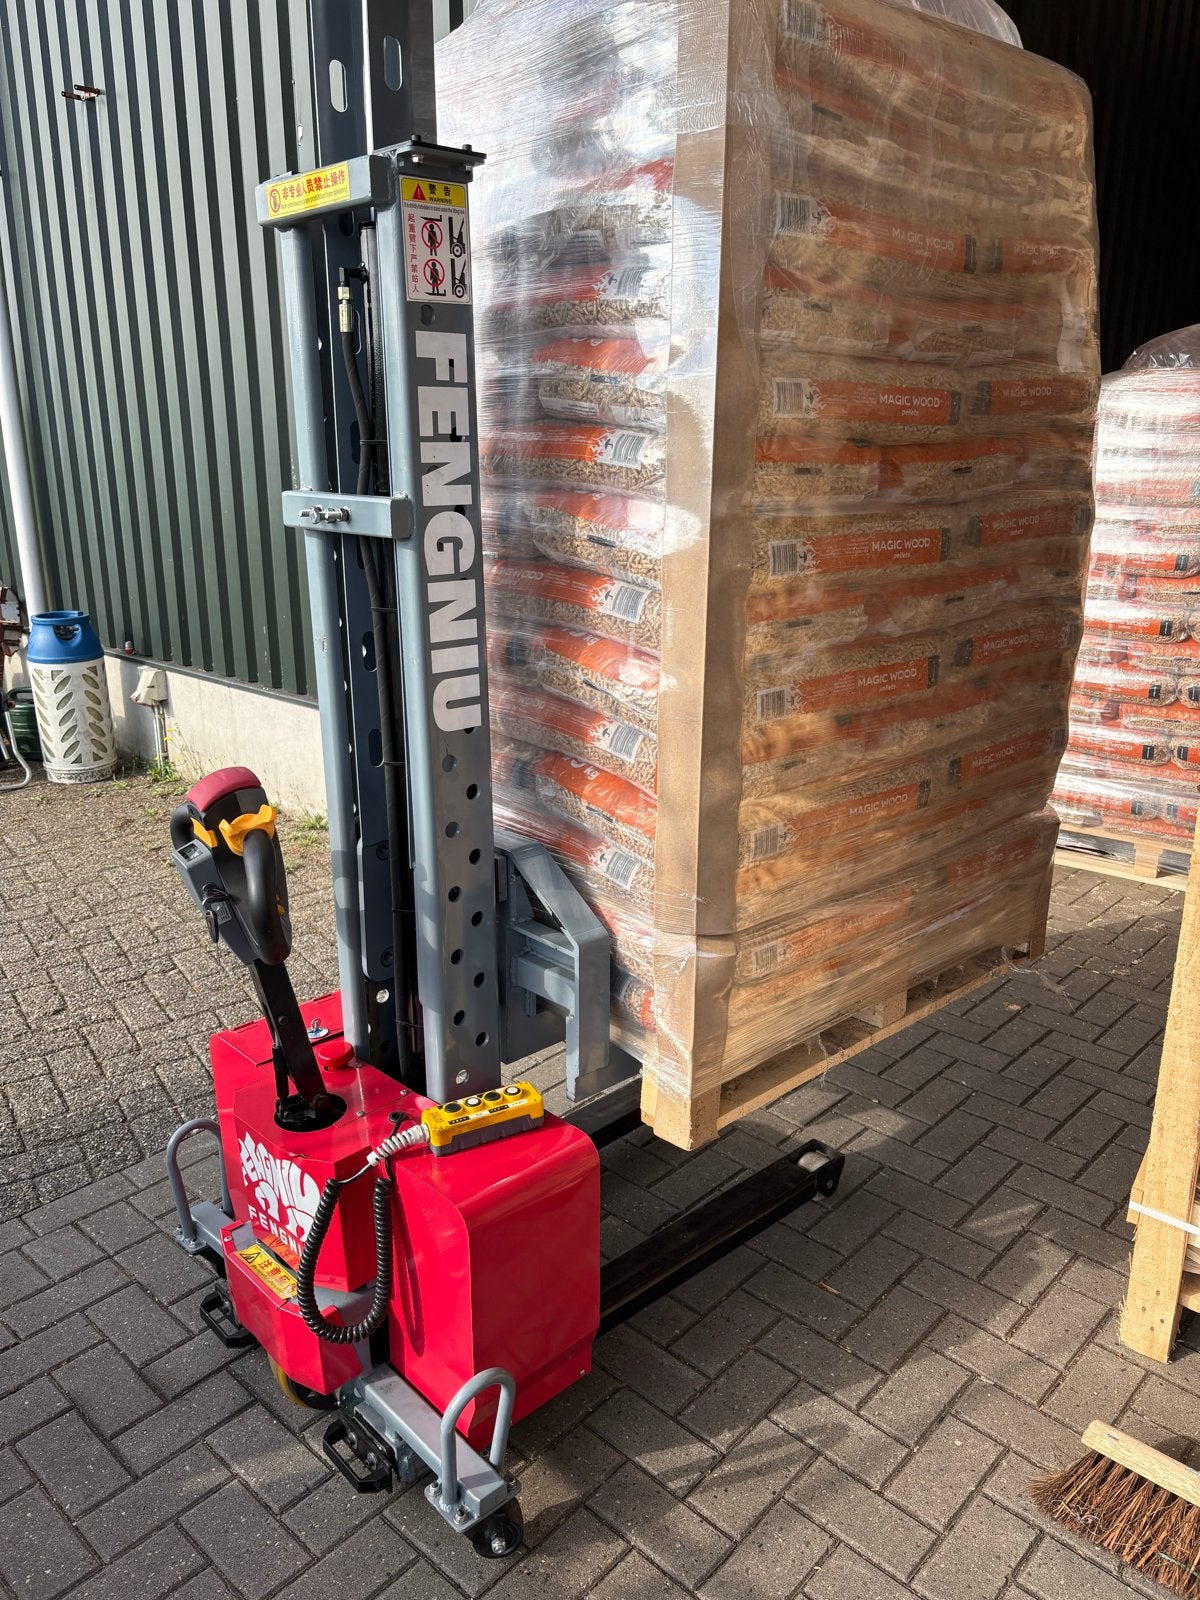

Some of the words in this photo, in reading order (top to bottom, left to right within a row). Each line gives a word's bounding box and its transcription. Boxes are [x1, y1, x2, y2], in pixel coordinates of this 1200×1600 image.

[282, 169, 345, 200] 非专业人员禁止操作
[428, 183, 451, 197] 警告
[892, 227, 924, 245] MAGIC
[925, 234, 955, 251] WOOD
[880, 393, 911, 406] MAGIC
[912, 396, 941, 408] WOOD
[1002, 386, 1027, 398] MAGIC
[1028, 386, 1052, 397] WOOD
[1018, 515, 1040, 526] WOOD
[415, 330, 482, 732] FENGNIU
[871, 540, 902, 551] MAGIC
[903, 537, 931, 549] WOOD
[1126, 620, 1150, 628] WOOD
[857, 673, 888, 687] MAGIC
[889, 668, 917, 681] WOOD
[848, 801, 880, 817] MAGIC
[881, 793, 908, 809] WOOD
[248, 1203, 303, 1259] FENGNI
